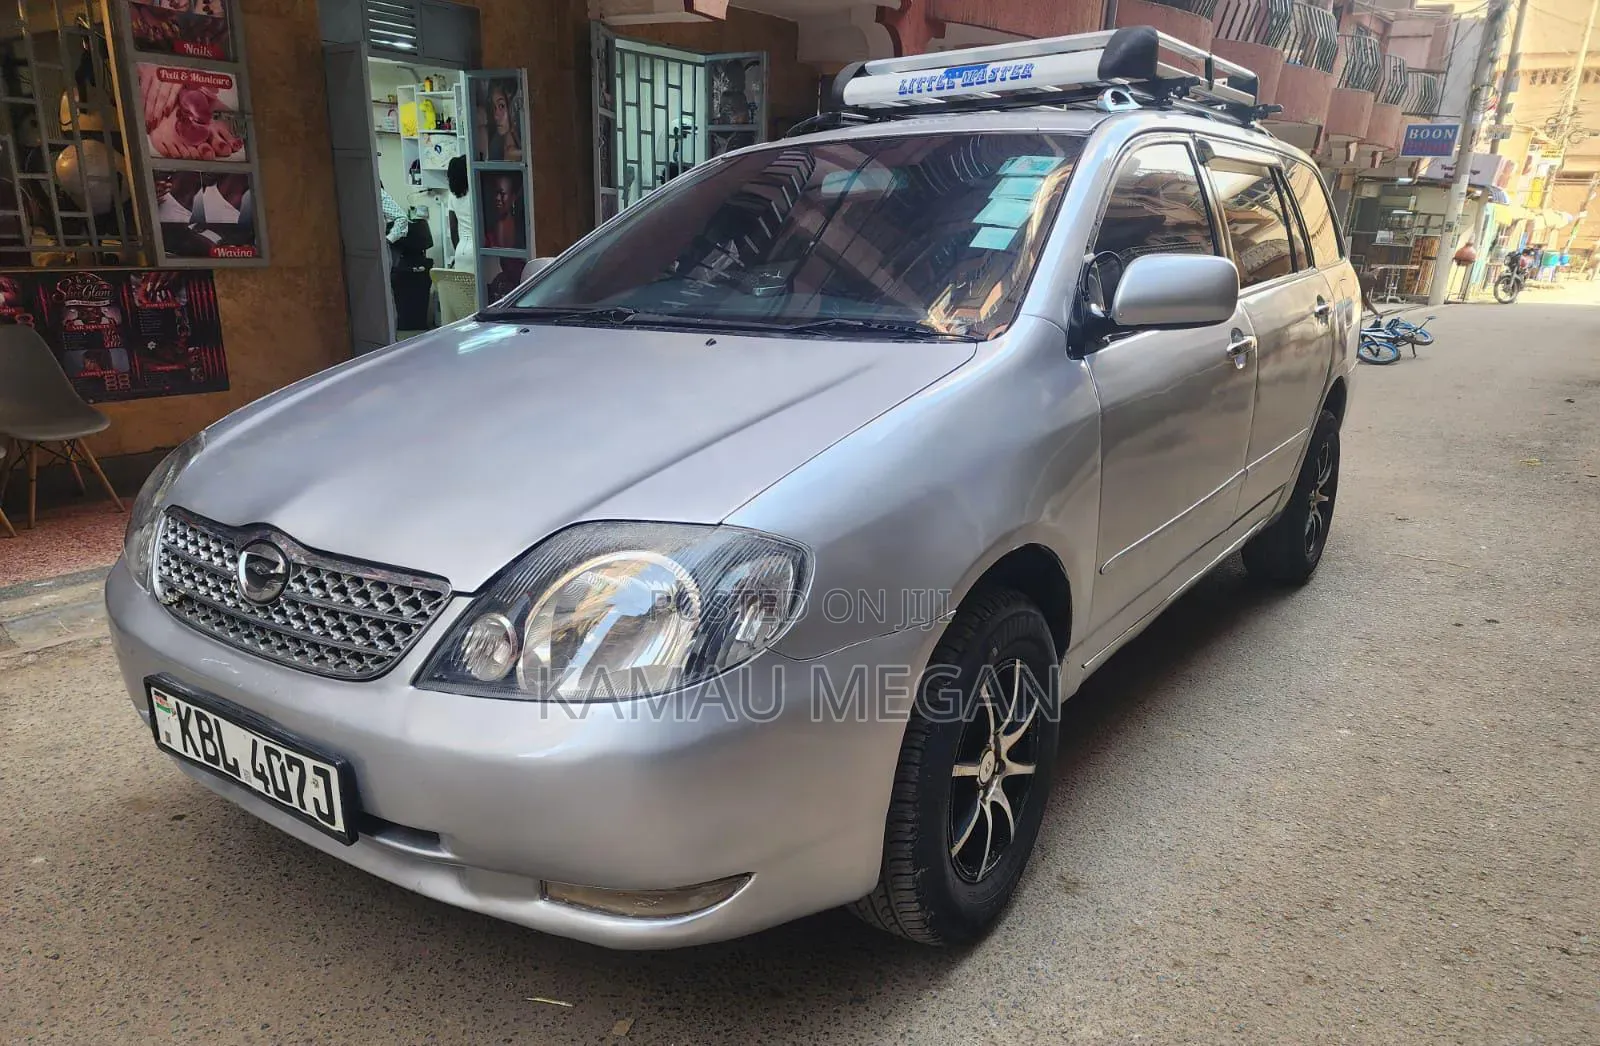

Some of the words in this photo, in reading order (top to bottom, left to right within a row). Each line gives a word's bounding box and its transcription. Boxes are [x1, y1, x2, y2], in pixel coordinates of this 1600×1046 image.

[183, 43, 213, 57] Nails
[180, 71, 188, 81] &
[961, 63, 1035, 86] MASTER
[1408, 127, 1456, 140] BOON
[175, 700, 242, 779] KBL
[251, 738, 337, 827] 407J
